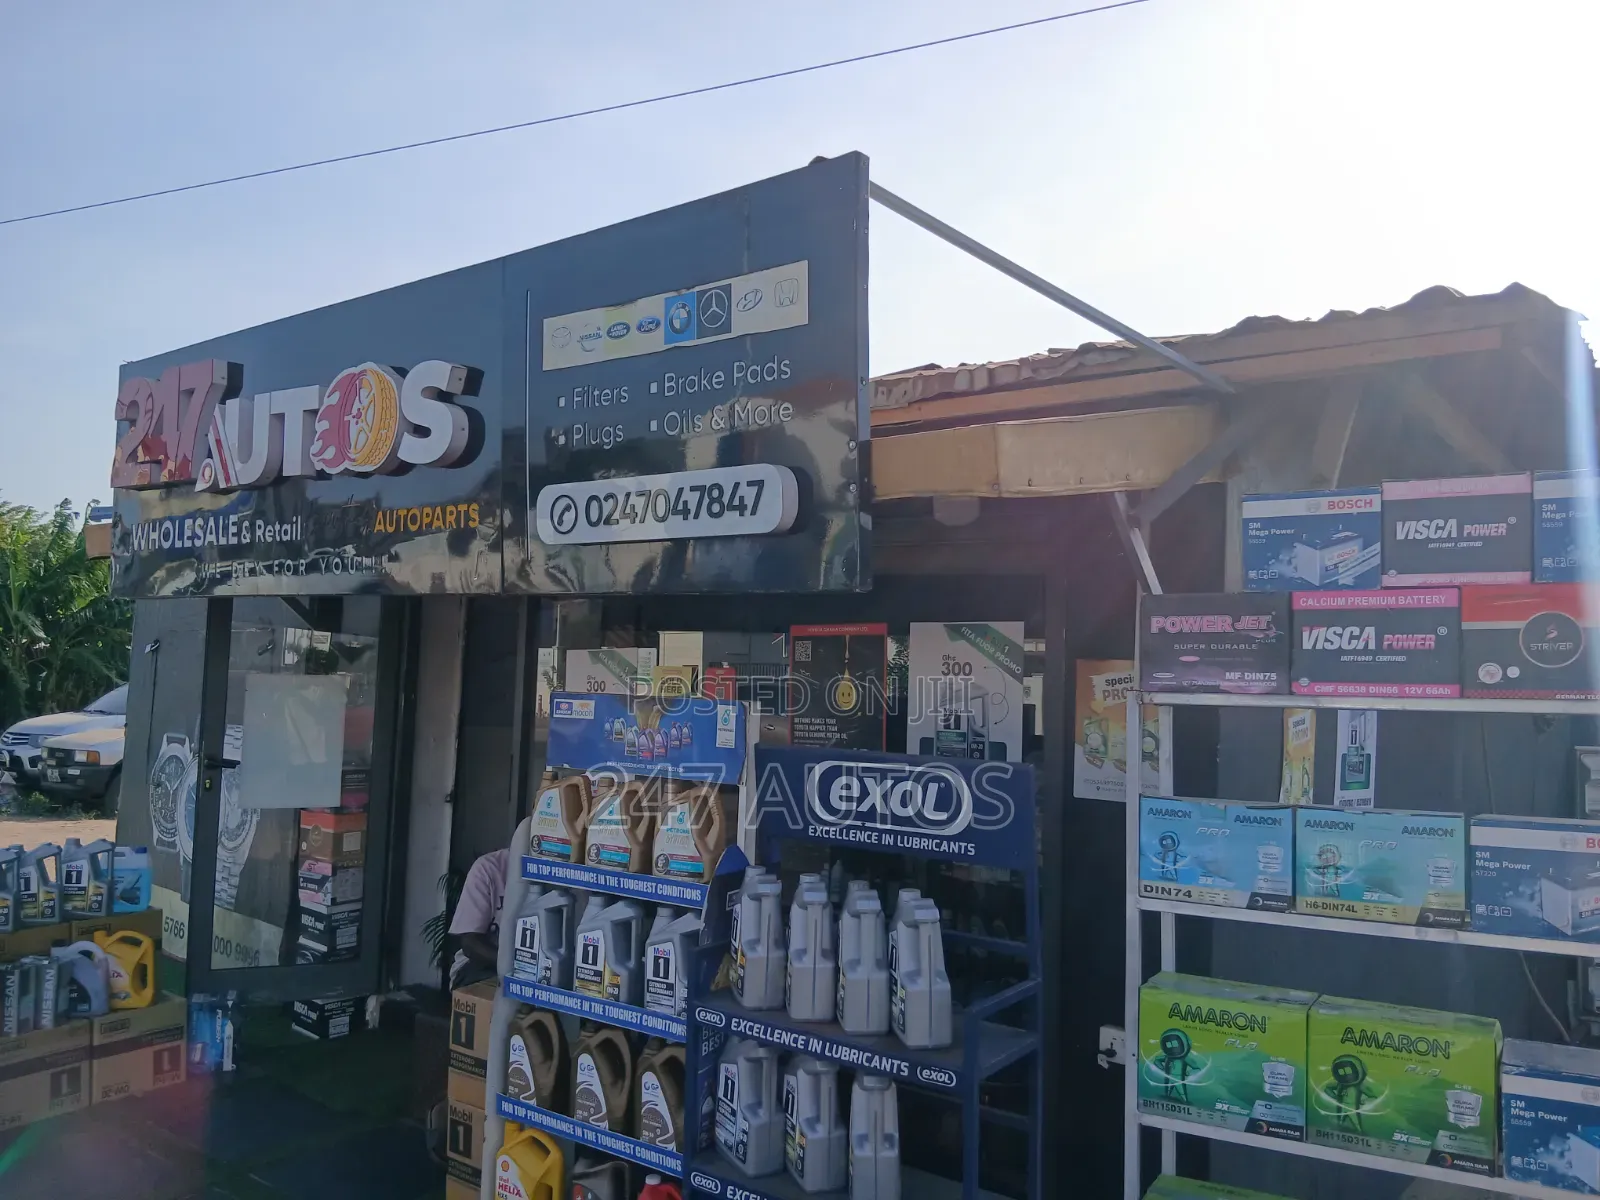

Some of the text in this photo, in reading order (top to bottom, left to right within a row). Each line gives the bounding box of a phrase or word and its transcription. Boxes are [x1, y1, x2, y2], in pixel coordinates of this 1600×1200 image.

[664, 355, 791, 397] Brake Pads
[573, 384, 628, 410] Filters
[110, 358, 222, 488] 247
[663, 400, 793, 436] Oils & More
[573, 422, 624, 450] Plugs
[584, 480, 765, 528] 0247047847
[1327, 498, 1374, 511] BOSCH
[373, 503, 480, 533] AUTOPARTS
[1541, 511, 1567, 521] Mega
[131, 514, 301, 551] WHOLESALE & Retail
[1248, 522, 1261, 530] SM
[1248, 527, 1295, 538] Mega Power
[1396, 518, 1507, 540] VISCA POWER
[272, 558, 306, 578] FOR
[1300, 595, 1446, 607] CALCIUM PREMIUM BATTERY
[1150, 615, 1272, 634] POWER JET
[1302, 626, 1436, 650] VISCA POWER
[1530, 642, 1573, 651] STRIVER
[961, 626, 977, 642] FITA
[995, 650, 1022, 675] PROMO
[1375, 655, 1406, 663] CERTIFIED
[941, 661, 973, 677] 300
[1225, 672, 1277, 681] MF DIN75
[586, 680, 606, 693] 300
[1314, 685, 1335, 694] CMF
[1369, 685, 1398, 695] DIN66
[1405, 686, 1423, 695] 12V
[1426, 686, 1451, 696] 66Ah
[1147, 806, 1192, 819] AMARON
[1233, 814, 1283, 827] AMARON
[1196, 827, 1231, 837] PRO
[1304, 818, 1355, 832] AMARON
[1401, 825, 1454, 838] AMARON
[808, 825, 976, 856] EXCELLENCE IN LUBRICANTS
[1475, 850, 1490, 859] SM
[66, 862, 84, 871] Mobil
[1475, 858, 1532, 870] Mega Power
[527, 863, 702, 902] FOR TOP PERFORMANCE IN THE TOUGHEST CONDITIONS
[1143, 884, 1193, 899] DIN74
[1305, 900, 1358, 914] H6-DIN74L
[163, 915, 186, 940] 5766
[213, 935, 232, 959] 000
[583, 934, 600, 945] Mobil
[653, 946, 671, 957] Mobil
[4, 975, 16, 1034] NISSAN
[41, 968, 56, 1026] NISSAN
[454, 997, 477, 1015] Mobil
[509, 983, 521, 995] FOR
[522, 986, 534, 998] TOP
[534, 988, 582, 1010] PERFORMANCE
[582, 999, 591, 1013] IN
[591, 1002, 605, 1016] THE
[605, 1004, 642, 1024] TOUGHEST
[642, 1014, 687, 1037] CONDITIONS
[1168, 1002, 1267, 1034] AMARON
[731, 1017, 806, 1050] EXCELLENCE
[808, 1038, 823, 1055] IN
[825, 1041, 910, 1077] LUBRICANTS
[1341, 1027, 1449, 1060] AMARON
[1143, 1100, 1193, 1117] BH115D31L
[1510, 1099, 1526, 1109] SM
[450, 1104, 473, 1124] Mobil
[1510, 1107, 1568, 1123] Mega Power
[501, 1100, 682, 1172] FOR TOP PERFORMANCE IN THE TOUGHEST CONDITIONS
[1315, 1130, 1372, 1148] BH115D31L
[497, 1183, 523, 1199] HELIX
